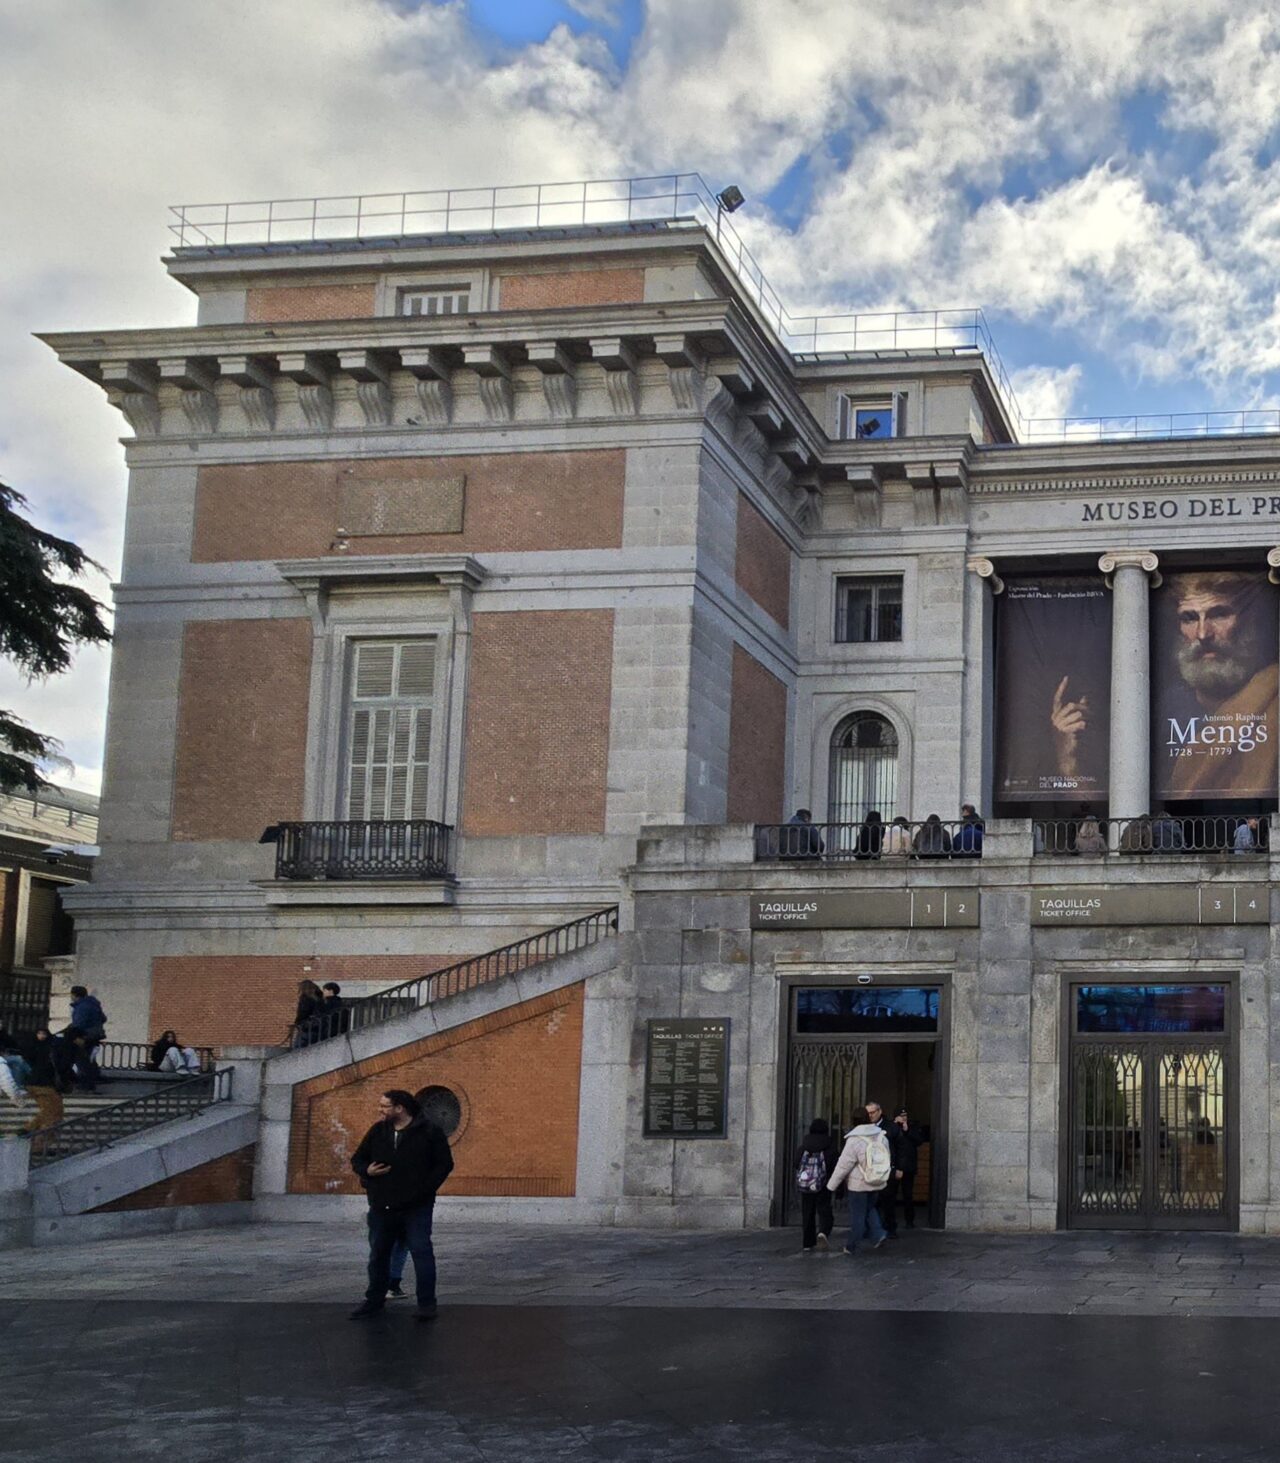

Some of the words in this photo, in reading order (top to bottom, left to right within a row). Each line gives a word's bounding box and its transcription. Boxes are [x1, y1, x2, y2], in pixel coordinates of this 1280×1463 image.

[1081, 500, 1178, 522] MUSEO
[1188, 498, 1242, 517] DEL
[1202, 713, 1234, 721] Antonio
[1235, 712, 1267, 722] Raphael
[1166, 717, 1268, 752] Mengs
[1169, 748, 1193, 757] 1728
[1210, 746, 1233, 756] 1779
[758, 903, 818, 912] TAQUILLAS
[1040, 899, 1101, 908] TAQUILLAS
[1214, 901, 1221, 910] 3
[1249, 900, 1256, 909] 4
[926, 904, 931, 913] 1
[958, 904, 965, 913] 2
